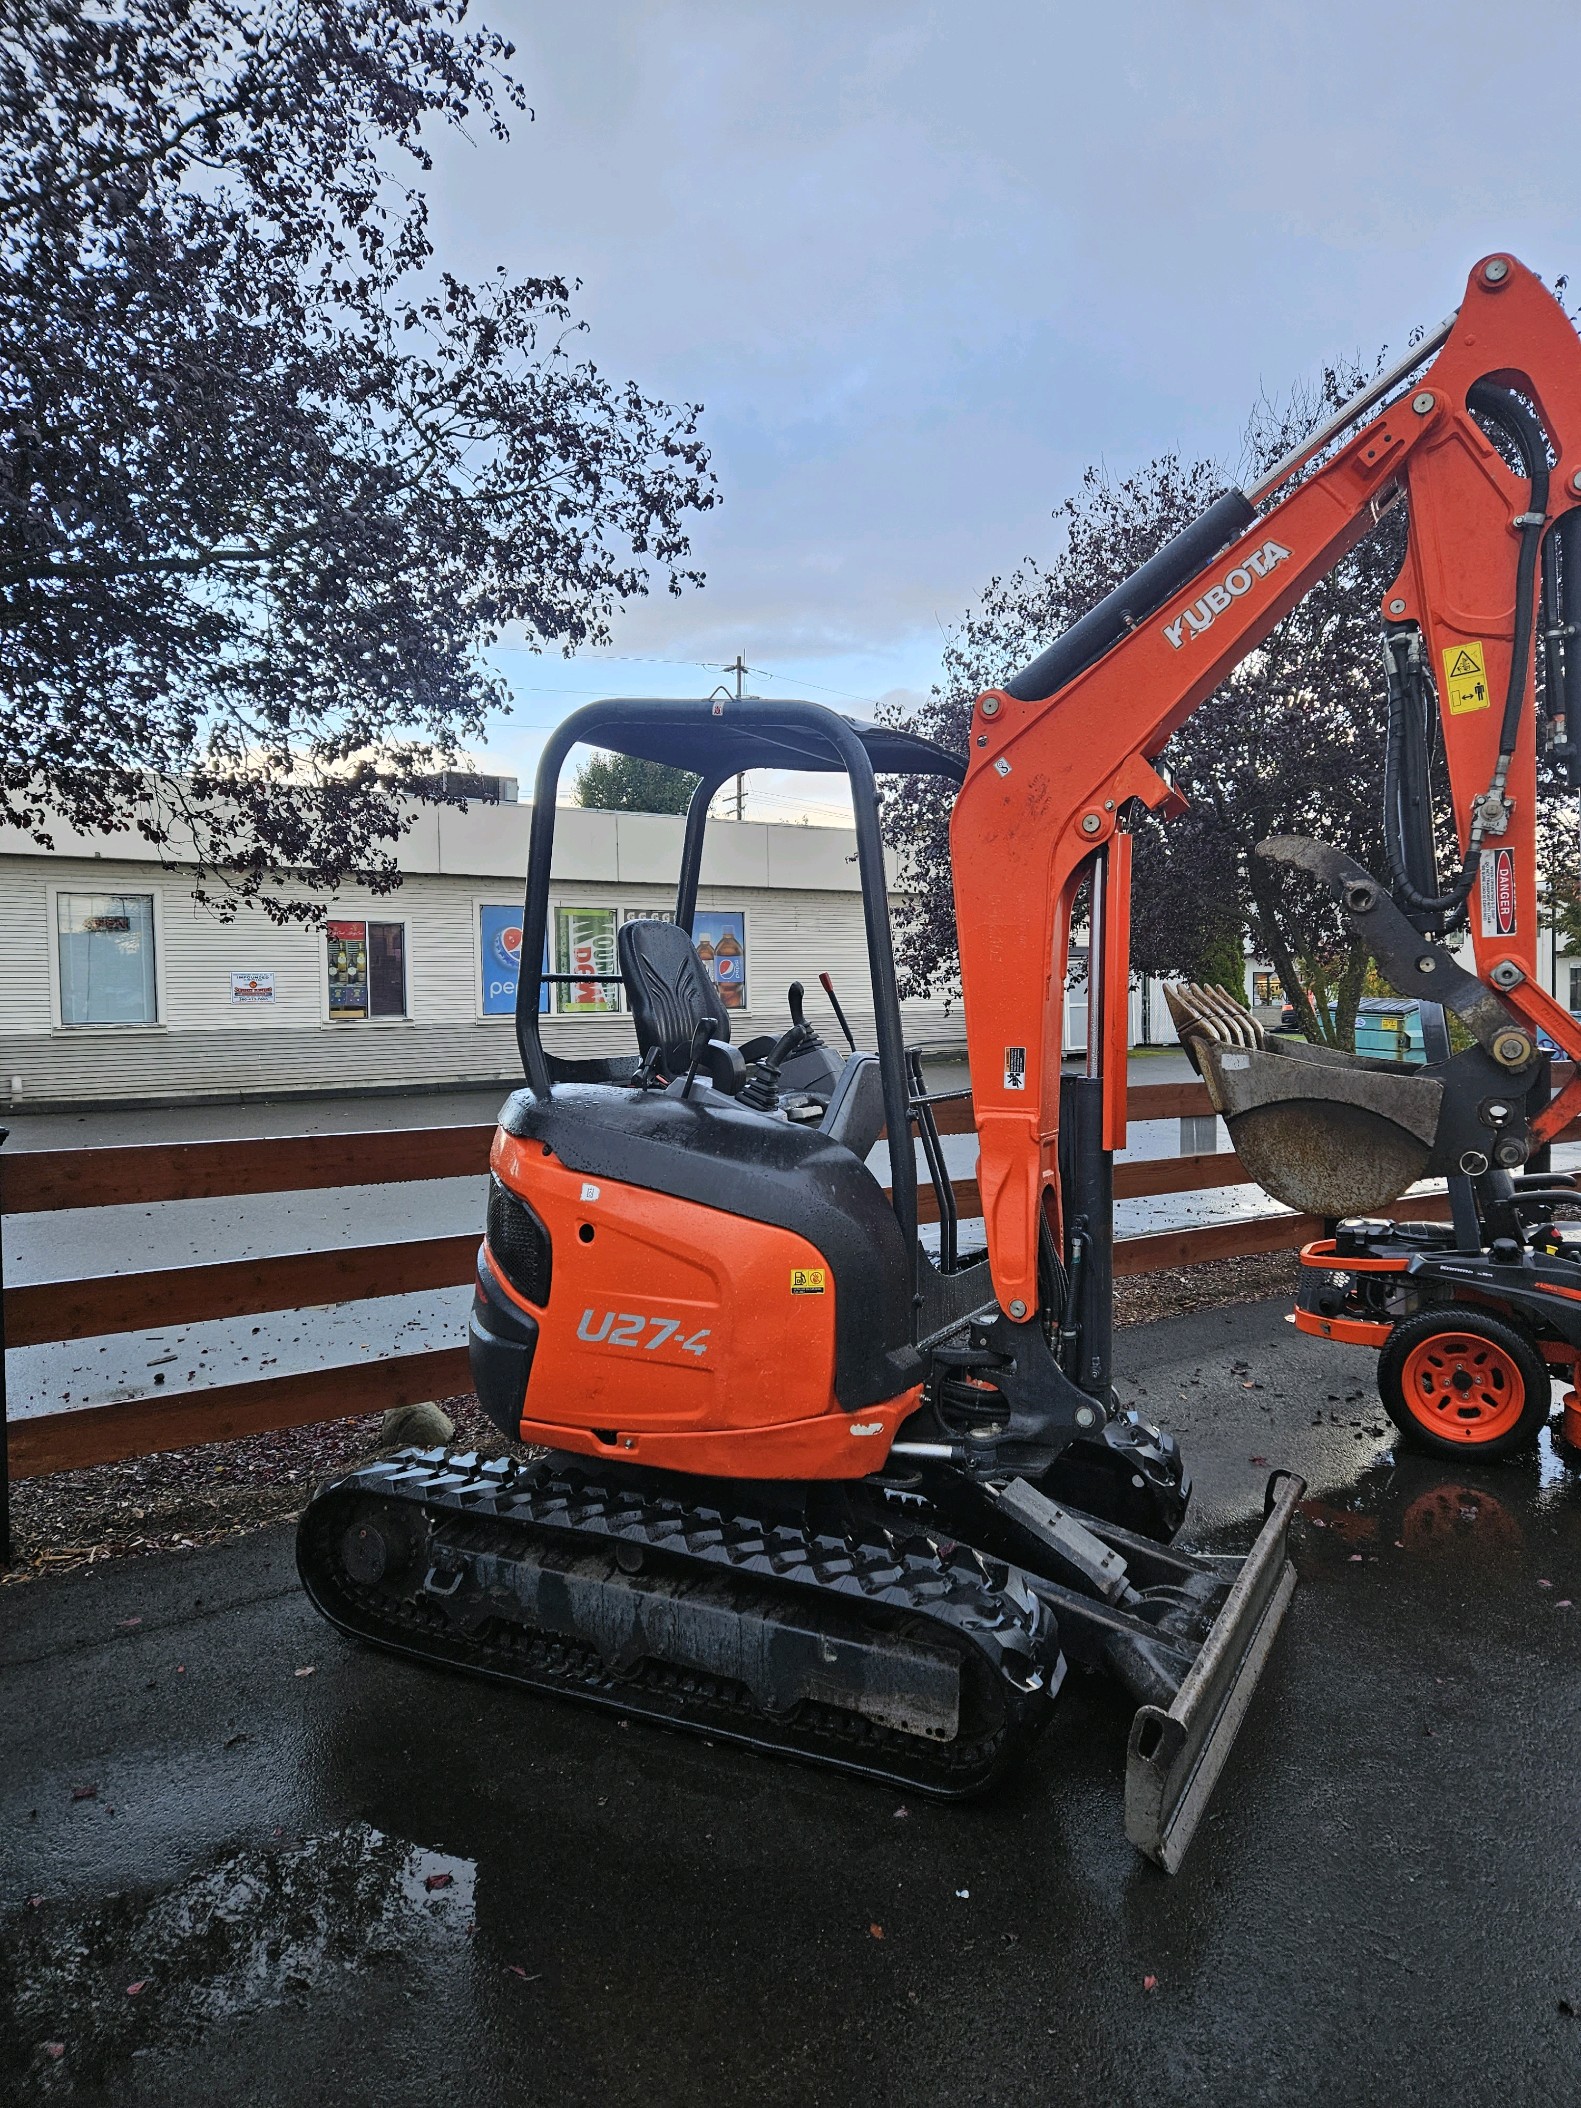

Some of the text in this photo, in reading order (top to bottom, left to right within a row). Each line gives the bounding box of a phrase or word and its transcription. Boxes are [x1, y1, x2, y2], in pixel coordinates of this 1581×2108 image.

[1162, 540, 1293, 649] KUBOTA
[1500, 869, 1509, 914] DANGER
[576, 1308, 711, 1356] U27-4
